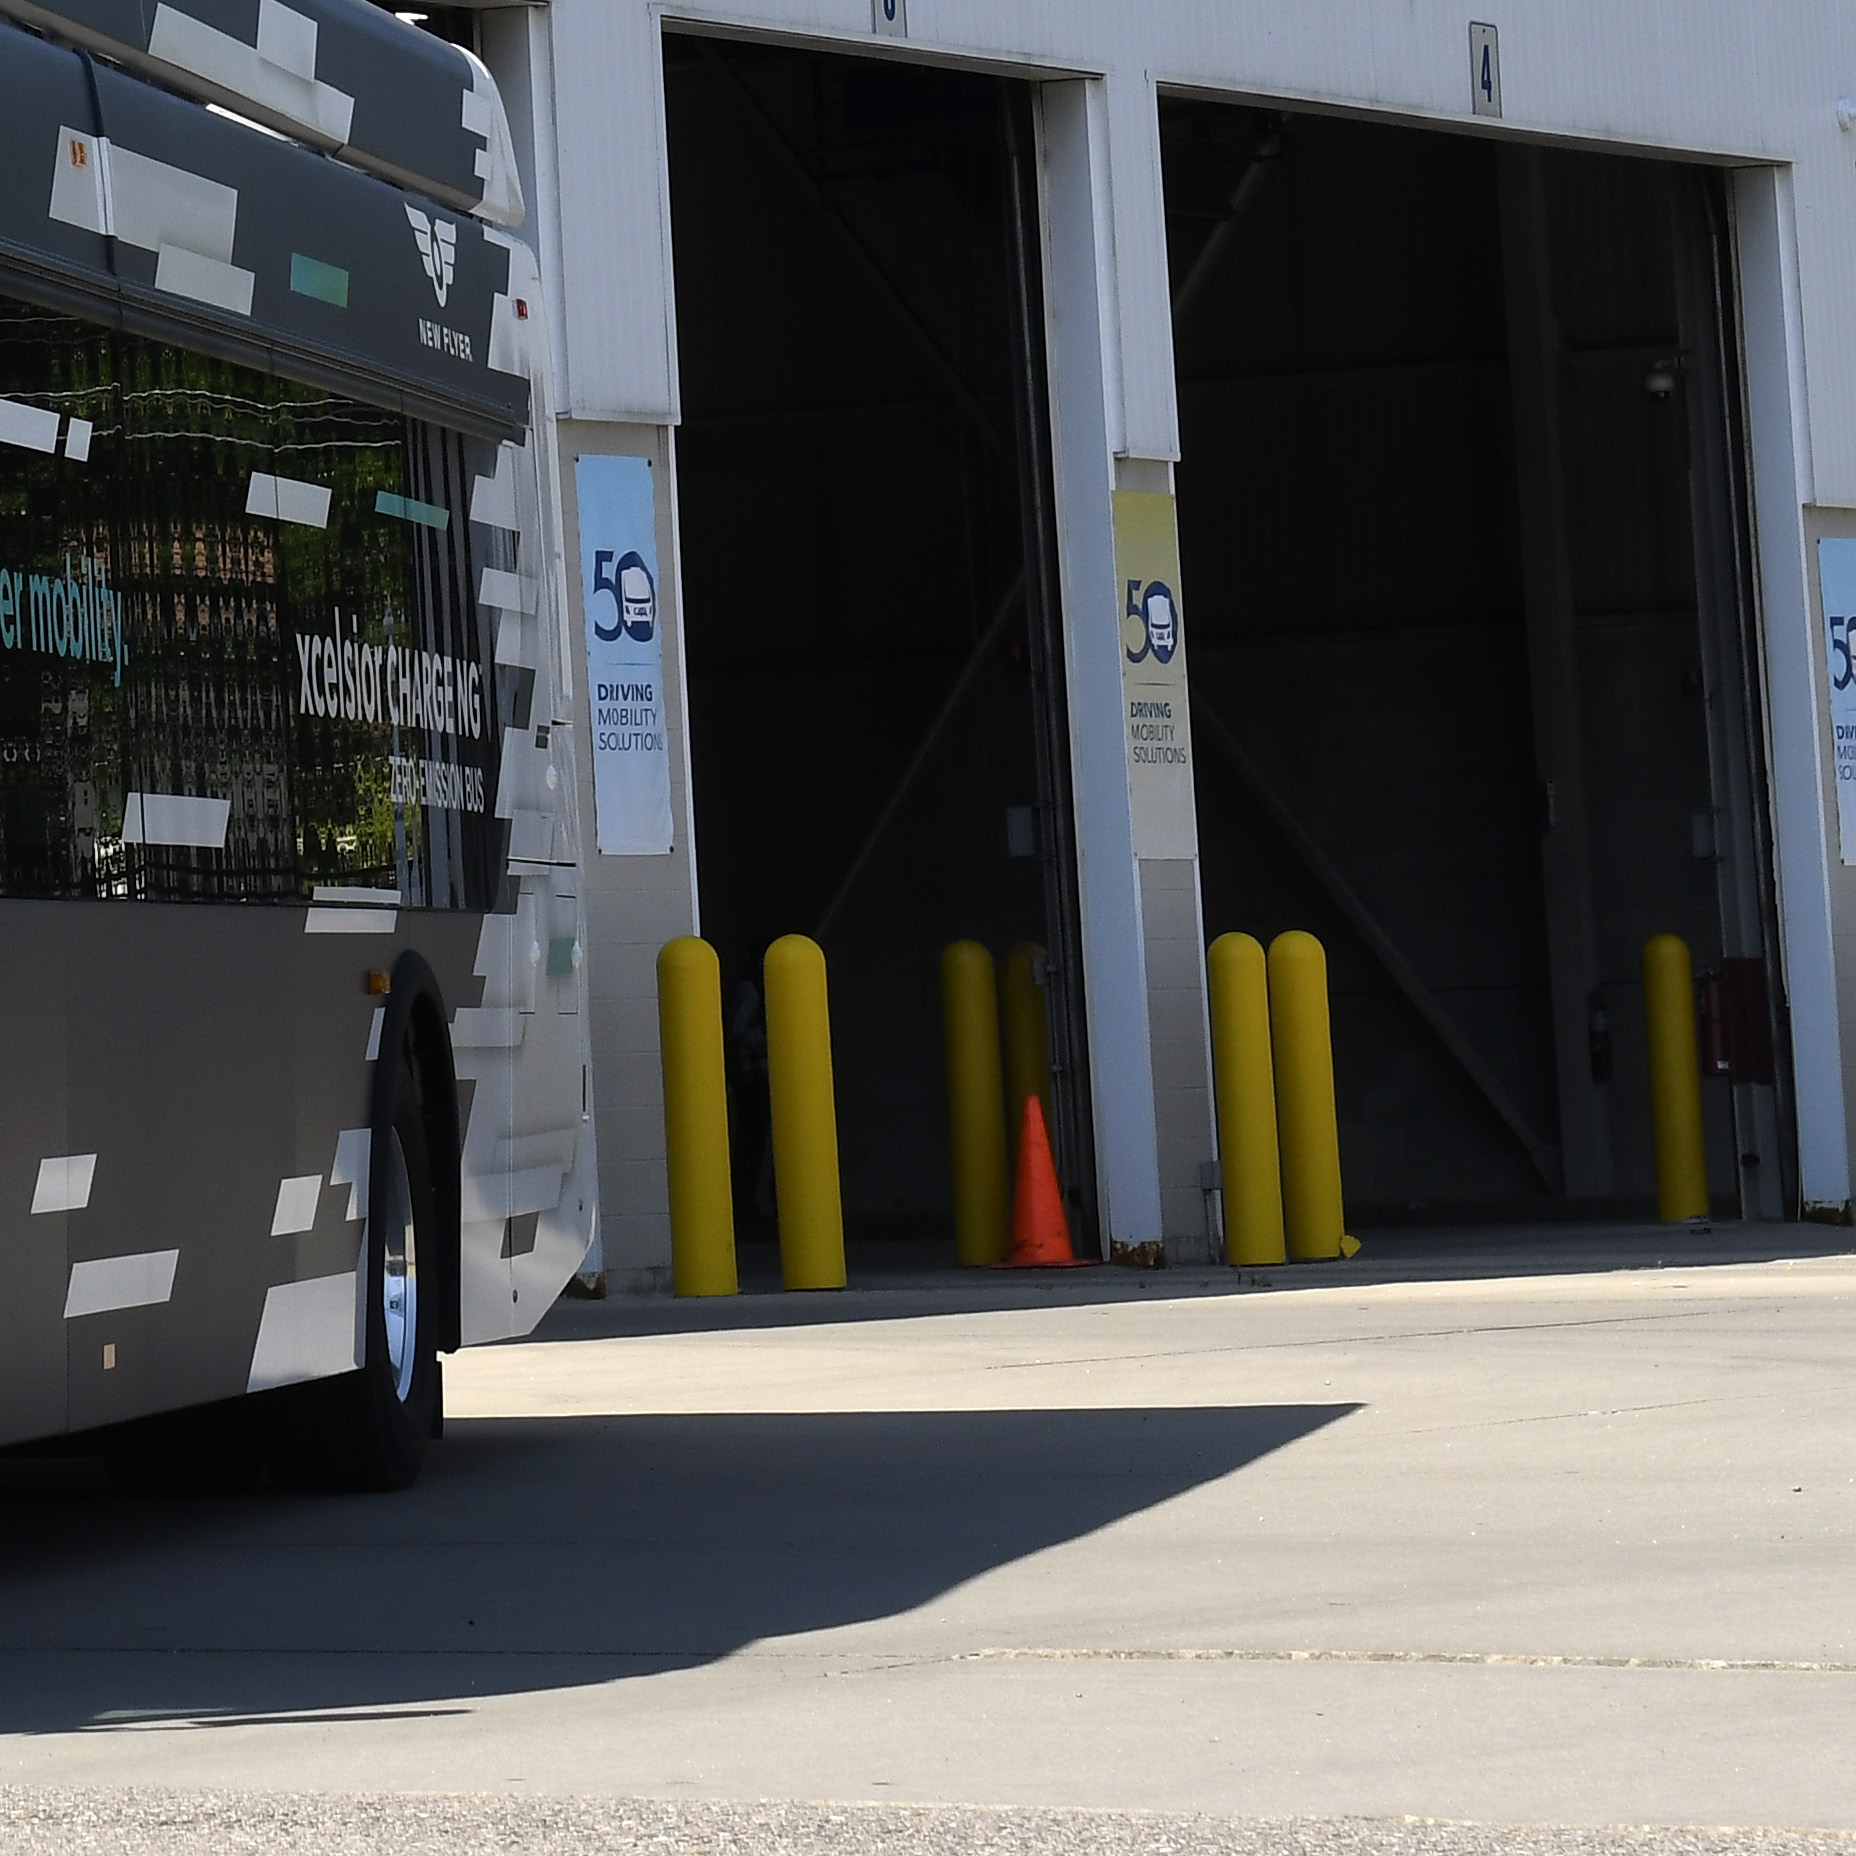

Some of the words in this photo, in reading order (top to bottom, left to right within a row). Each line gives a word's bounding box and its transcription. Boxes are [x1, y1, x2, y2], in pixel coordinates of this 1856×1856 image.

[1481, 44, 1492, 103] 4
[418, 318, 441, 350] NEW
[443, 327, 473, 362] FLYER
[592, 550, 656, 643] 50
[1126, 579, 1179, 664] 50
[296, 606, 383, 723] xcelsior
[387, 644, 455, 734] CHARGE
[597, 683, 653, 702] DRIVING
[598, 707, 657, 726] MOBILITY
[1130, 701, 1172, 719] DRIVING
[1133, 746, 1186, 764] SOLUTIONS
[465, 765, 485, 813] BUS
